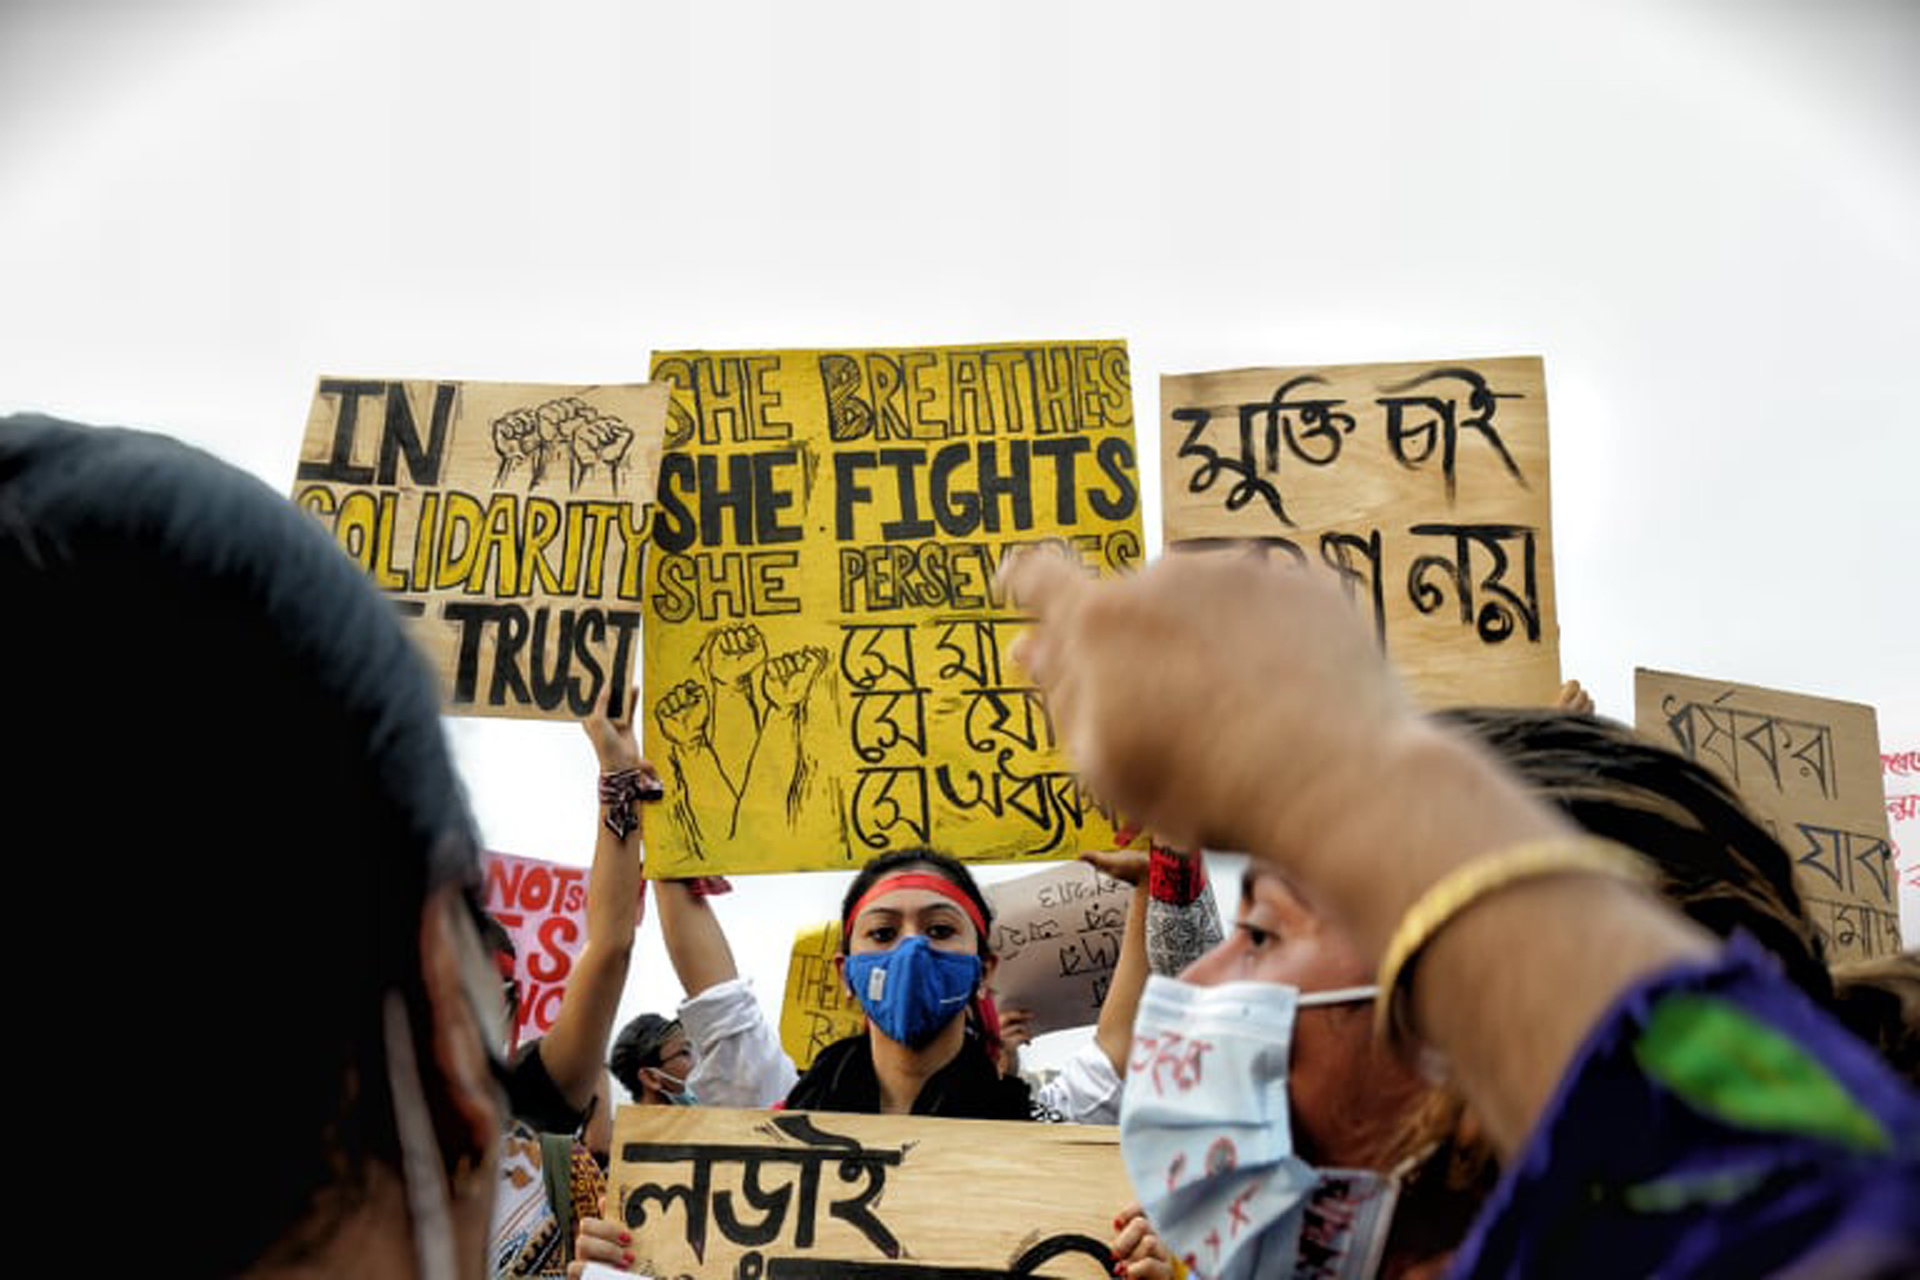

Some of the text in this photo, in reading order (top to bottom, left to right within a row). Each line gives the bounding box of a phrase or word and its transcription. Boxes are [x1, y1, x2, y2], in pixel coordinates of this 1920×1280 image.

[296, 379, 457, 486] IN
[651, 345, 1134, 448] SHE BREATHES
[1171, 368, 1532, 527] মুক্তি চাই
[652, 437, 1139, 554] SHE FIGHTS
[652, 549, 801, 622] SHE
[1408, 524, 1541, 645] নয়
[445, 602, 641, 719] TRUST
[841, 625, 916, 690] সে
[850, 687, 932, 763] সে
[852, 766, 930, 849] সে
[622, 1115, 914, 1275] লড়াই
